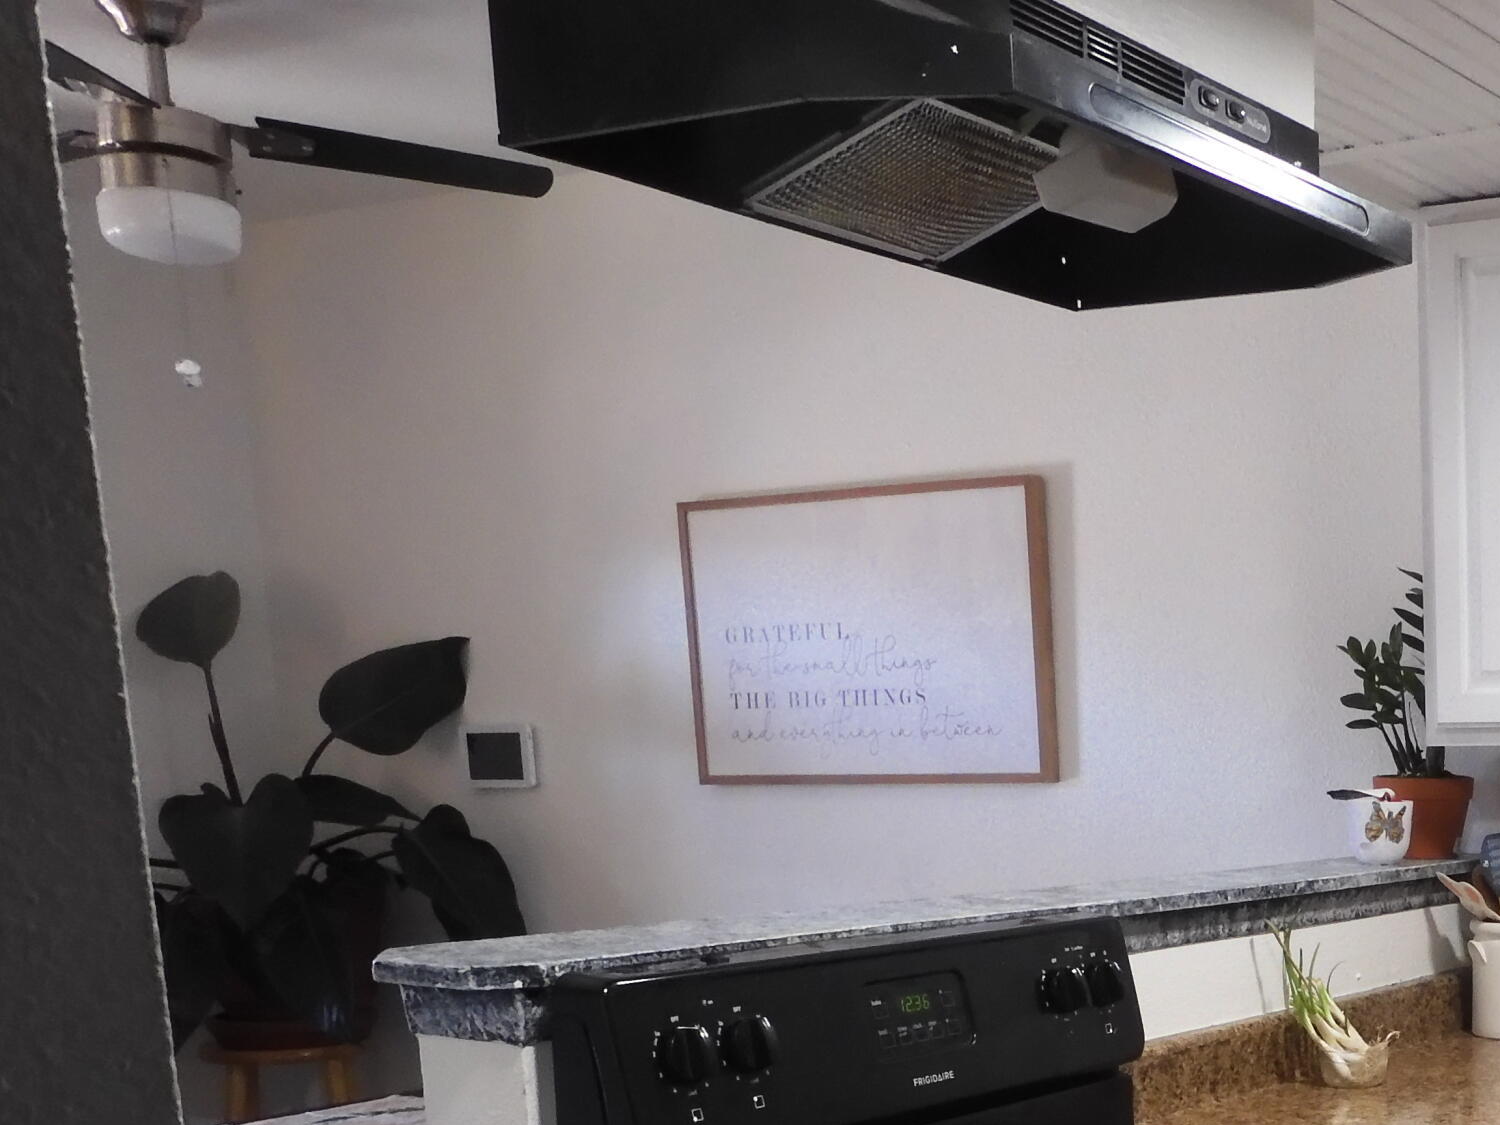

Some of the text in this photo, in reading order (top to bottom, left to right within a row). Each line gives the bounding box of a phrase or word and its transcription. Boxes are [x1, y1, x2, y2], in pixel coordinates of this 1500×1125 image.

[725, 621, 850, 645] GRATEFUL
[862, 634, 937, 690] things
[729, 687, 928, 710] THE BIG THINGS
[731, 710, 772, 742] and
[912, 704, 1003, 741] between
[912, 1070, 955, 1087] FRIGIDAIRE
